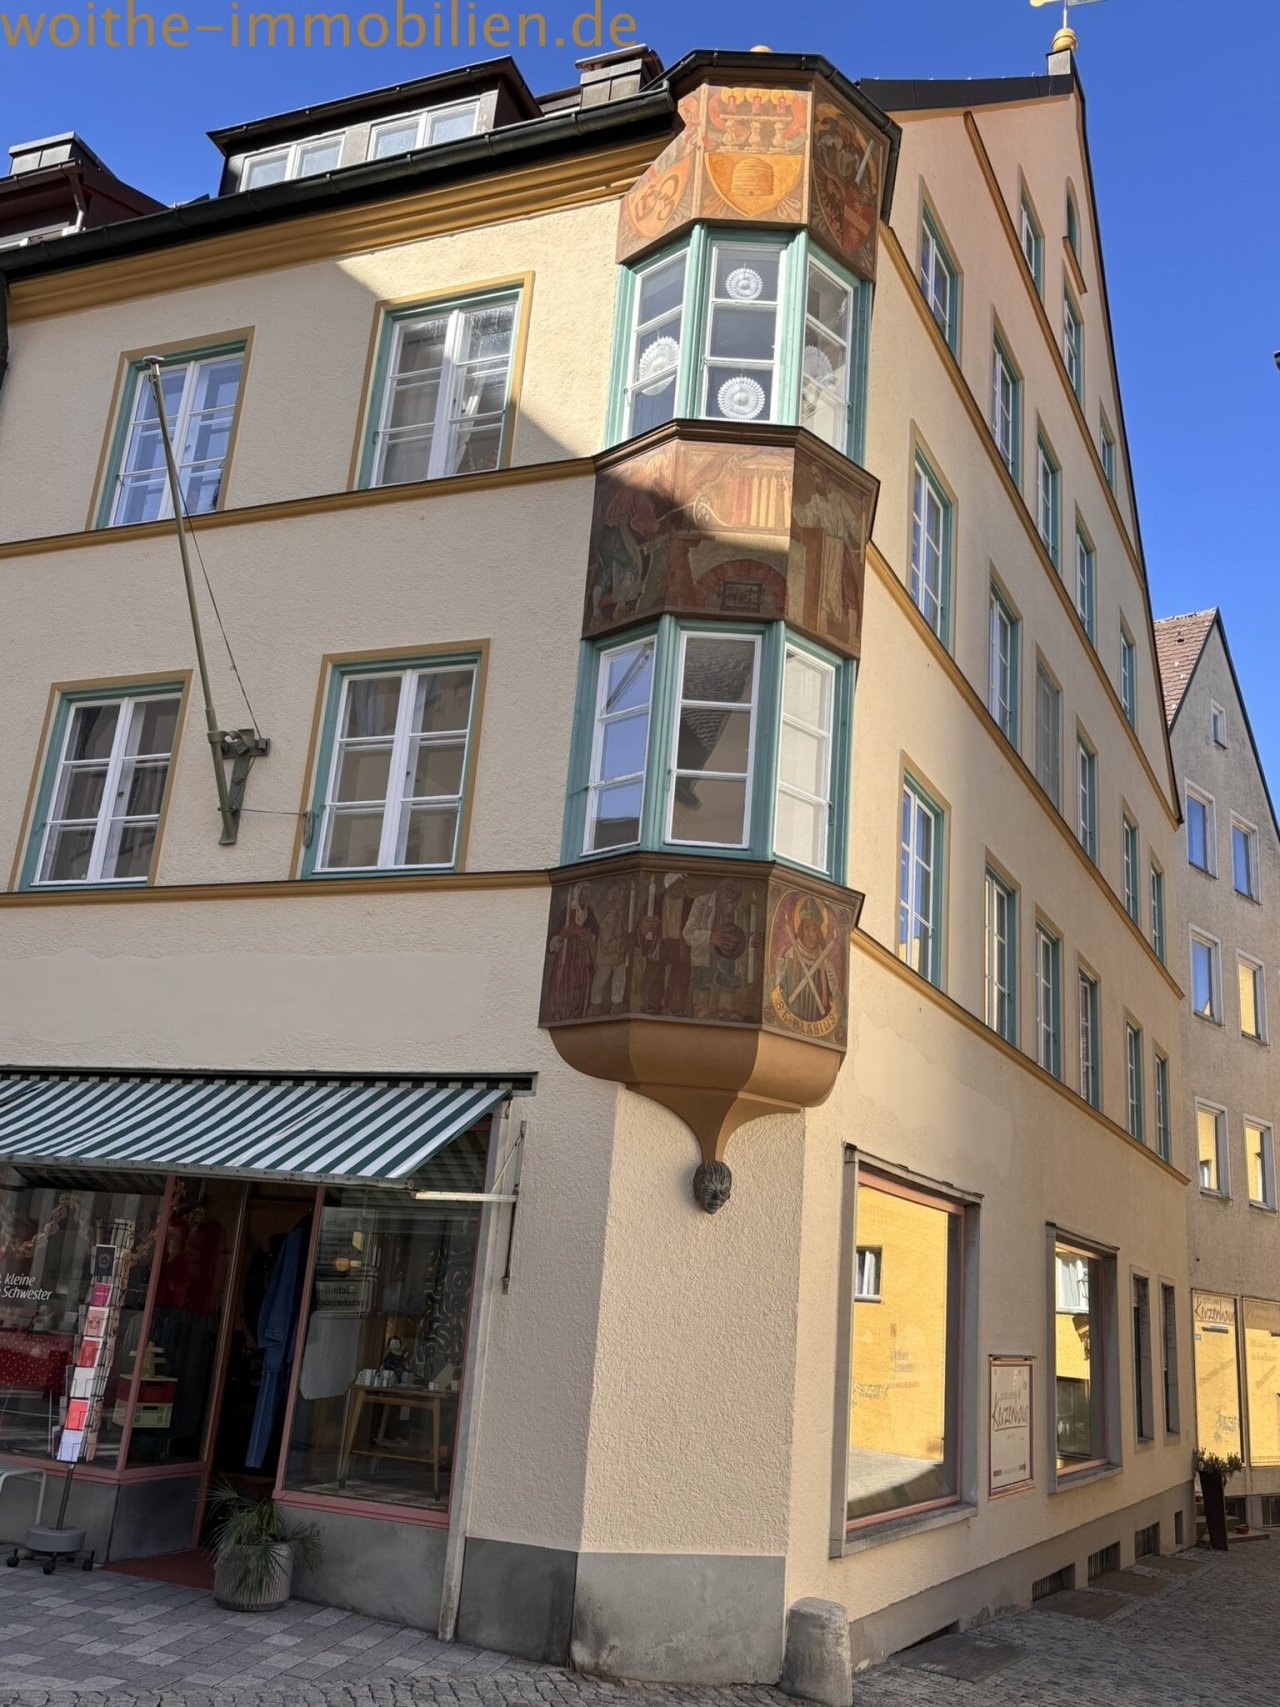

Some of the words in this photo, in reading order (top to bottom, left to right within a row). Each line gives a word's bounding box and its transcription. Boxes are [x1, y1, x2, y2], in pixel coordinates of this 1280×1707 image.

[792, 1014, 837, 1036] BLASIUS
[4, 1273, 36, 1286] kleine
[1, 1285, 53, 1300] Schwester
